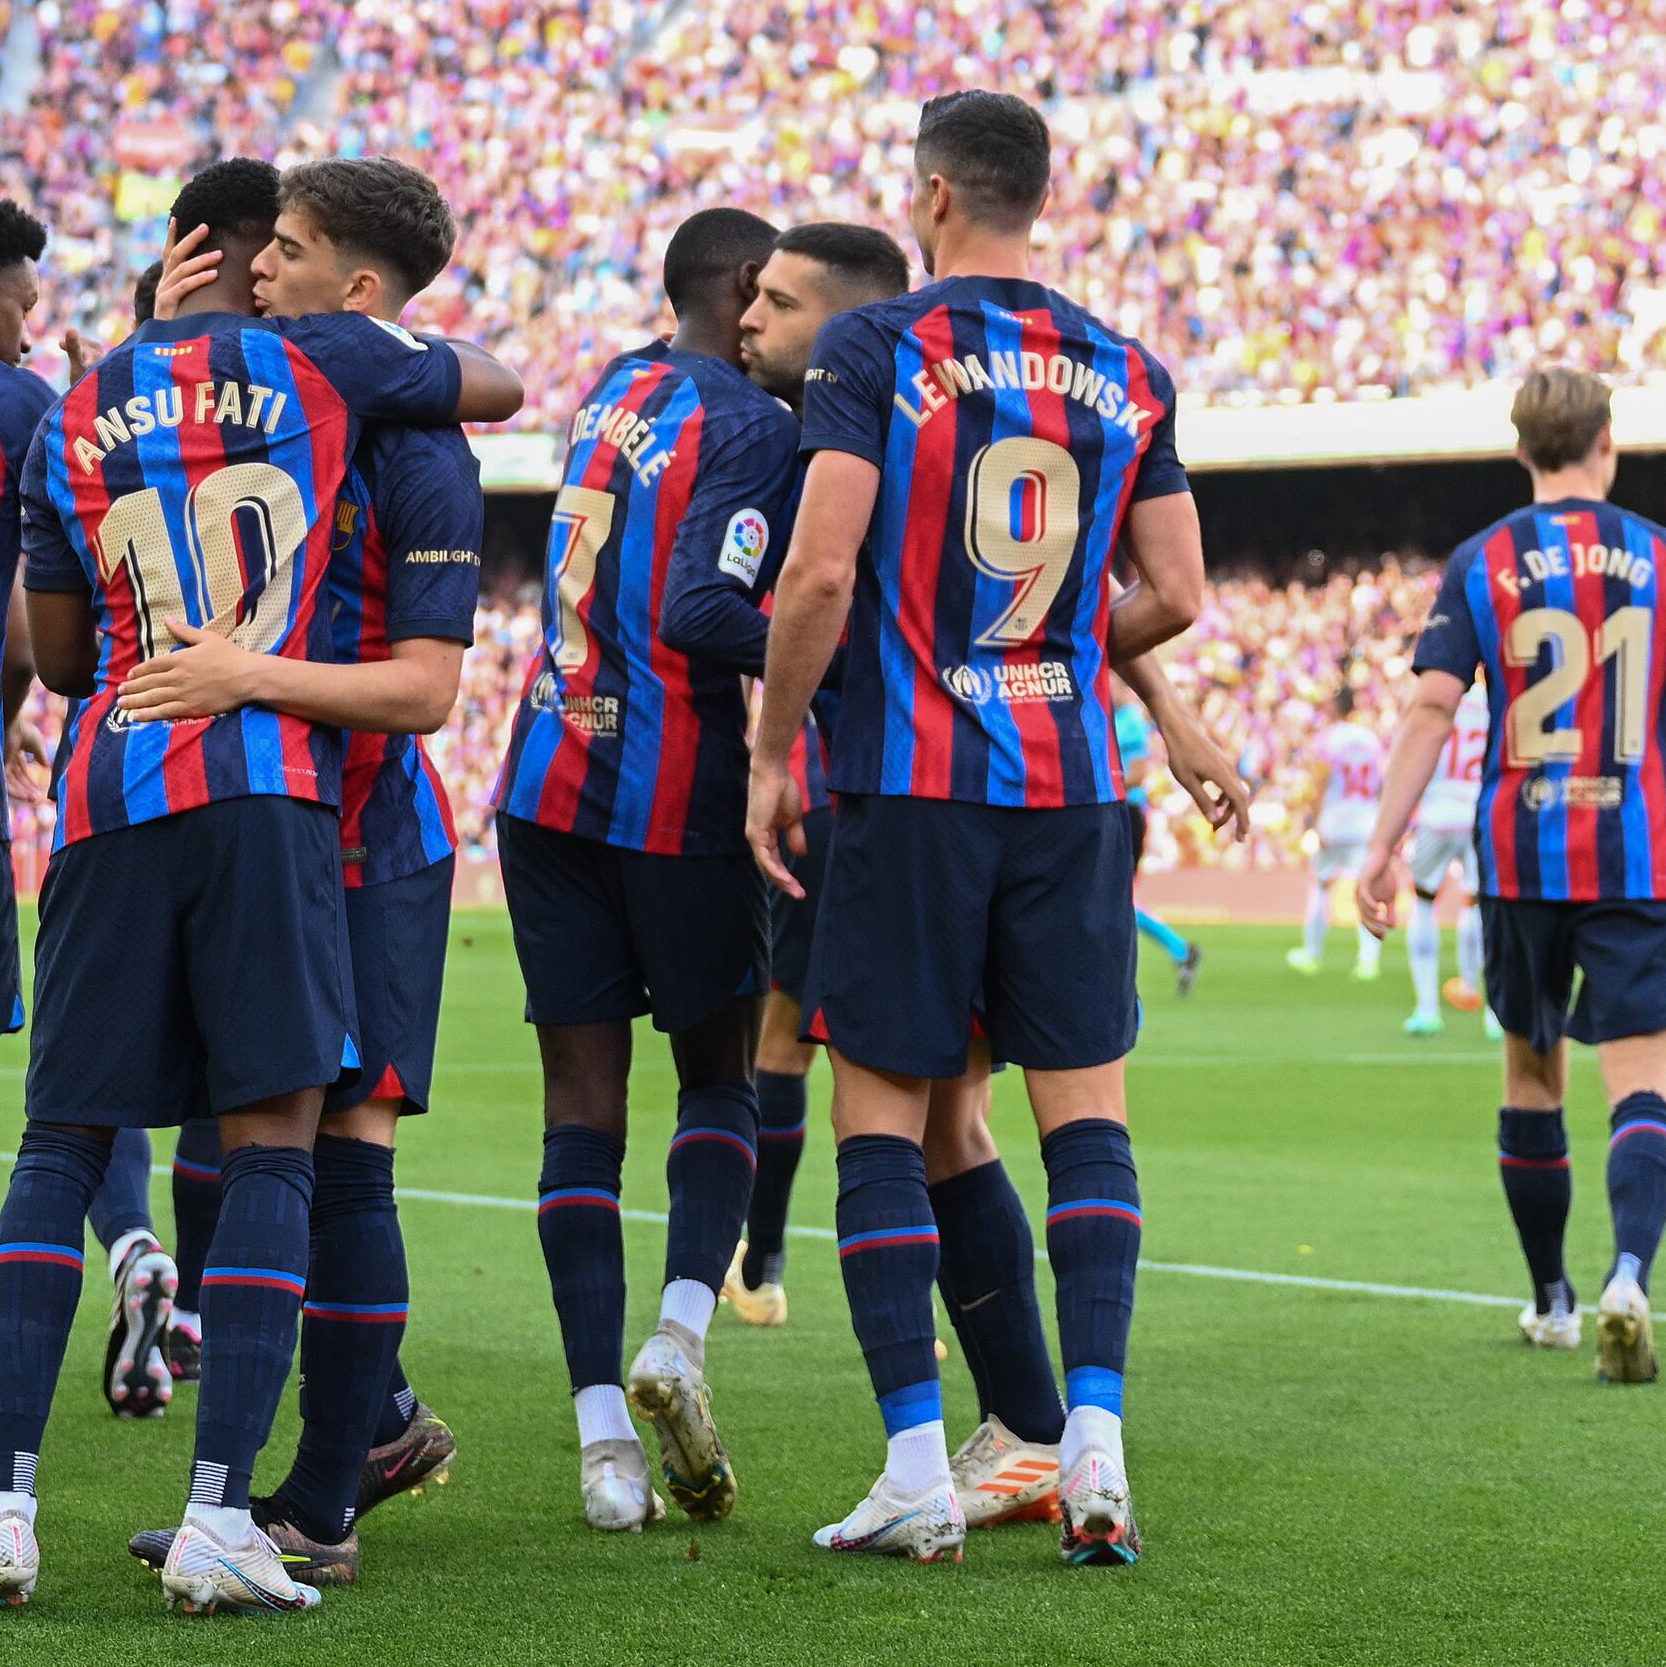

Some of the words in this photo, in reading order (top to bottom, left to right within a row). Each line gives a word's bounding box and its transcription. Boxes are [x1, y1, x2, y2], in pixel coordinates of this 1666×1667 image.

[73, 386, 183, 476] ANSU
[195, 381, 287, 435] FATI
[571, 403, 677, 488] DEMBÉLÉ
[894, 351, 1151, 449] LEWANDOWSK
[93, 462, 308, 664] 10
[552, 484, 615, 675] 7
[964, 436, 1081, 647] 9
[1496, 568, 1532, 597] F.
[1523, 545, 1569, 581] DE
[1571, 542, 1653, 589] JONG
[994, 661, 1069, 683] UNHCR
[997, 677, 1073, 698] ACNUR
[1504, 606, 1653, 769] 21
